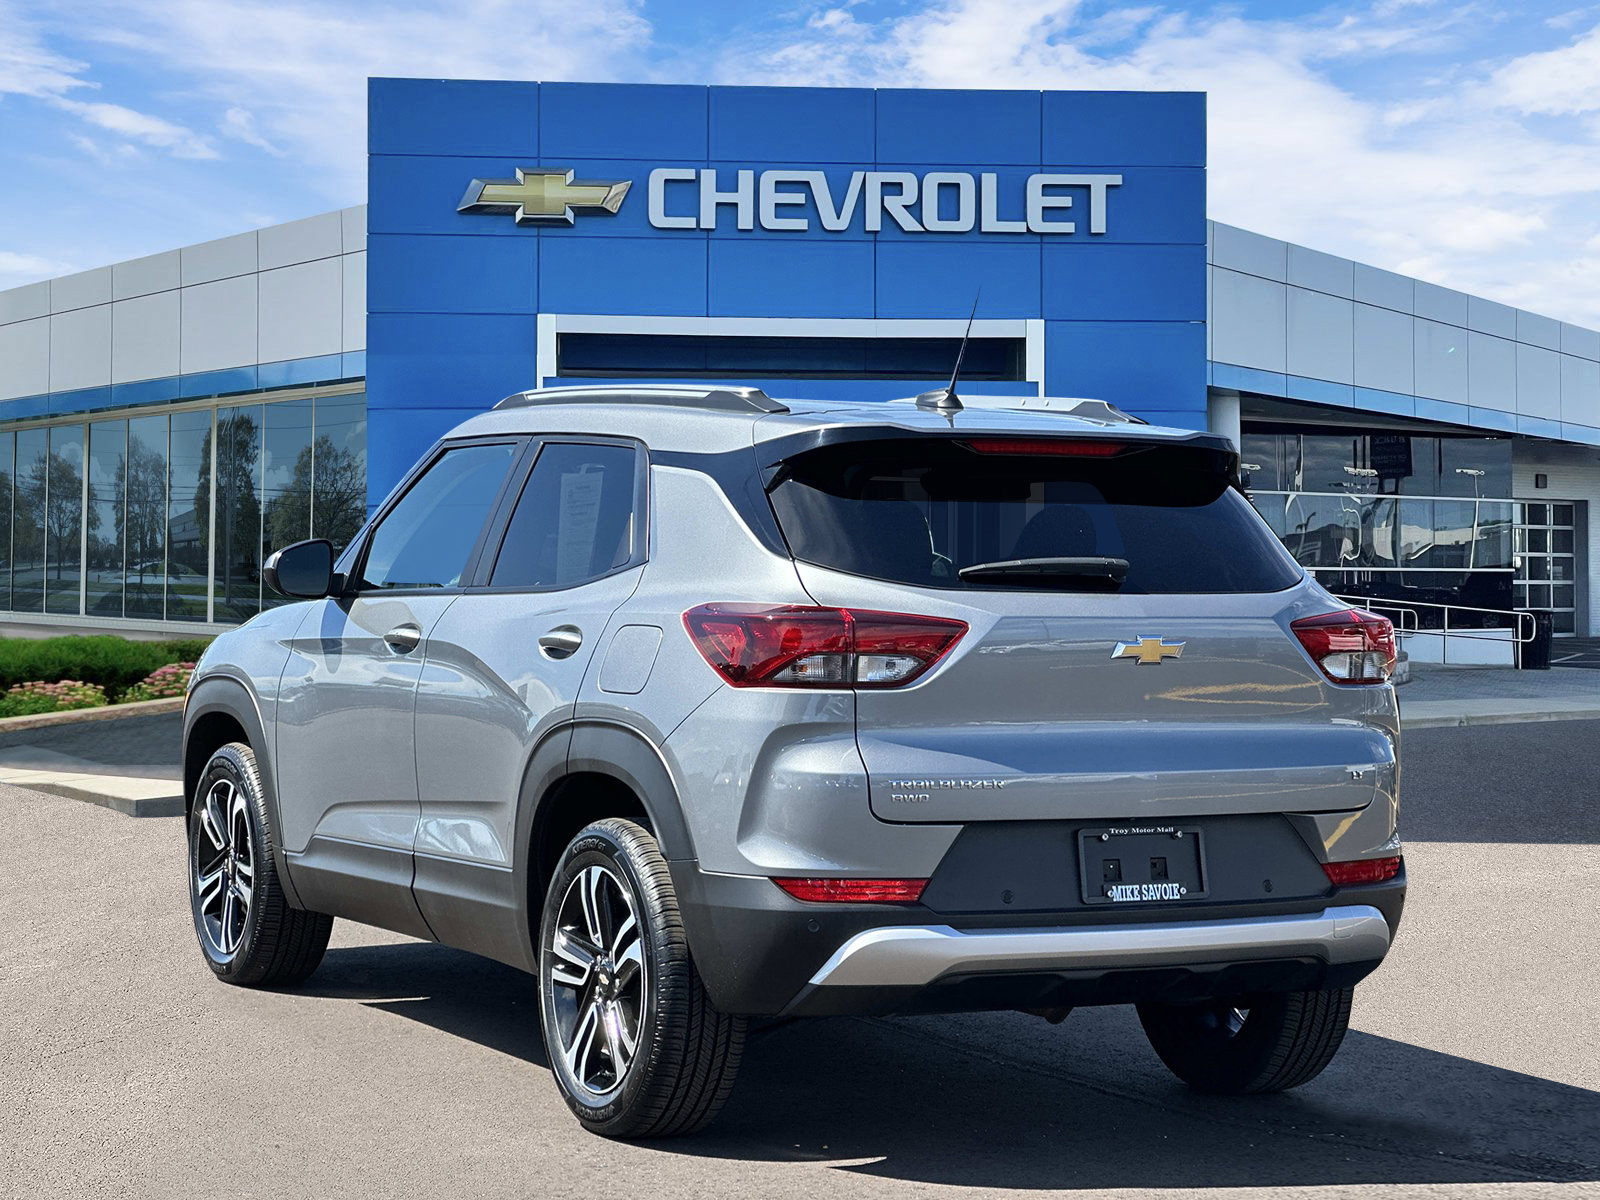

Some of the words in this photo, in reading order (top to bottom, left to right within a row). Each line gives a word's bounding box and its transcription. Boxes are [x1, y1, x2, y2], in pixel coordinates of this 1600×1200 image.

[648, 168, 1123, 234] CHEVROLET
[888, 779, 1006, 790] TRAILBLAZER
[1112, 884, 1141, 902] MIKE
[1141, 883, 1181, 901] SAVOIE
